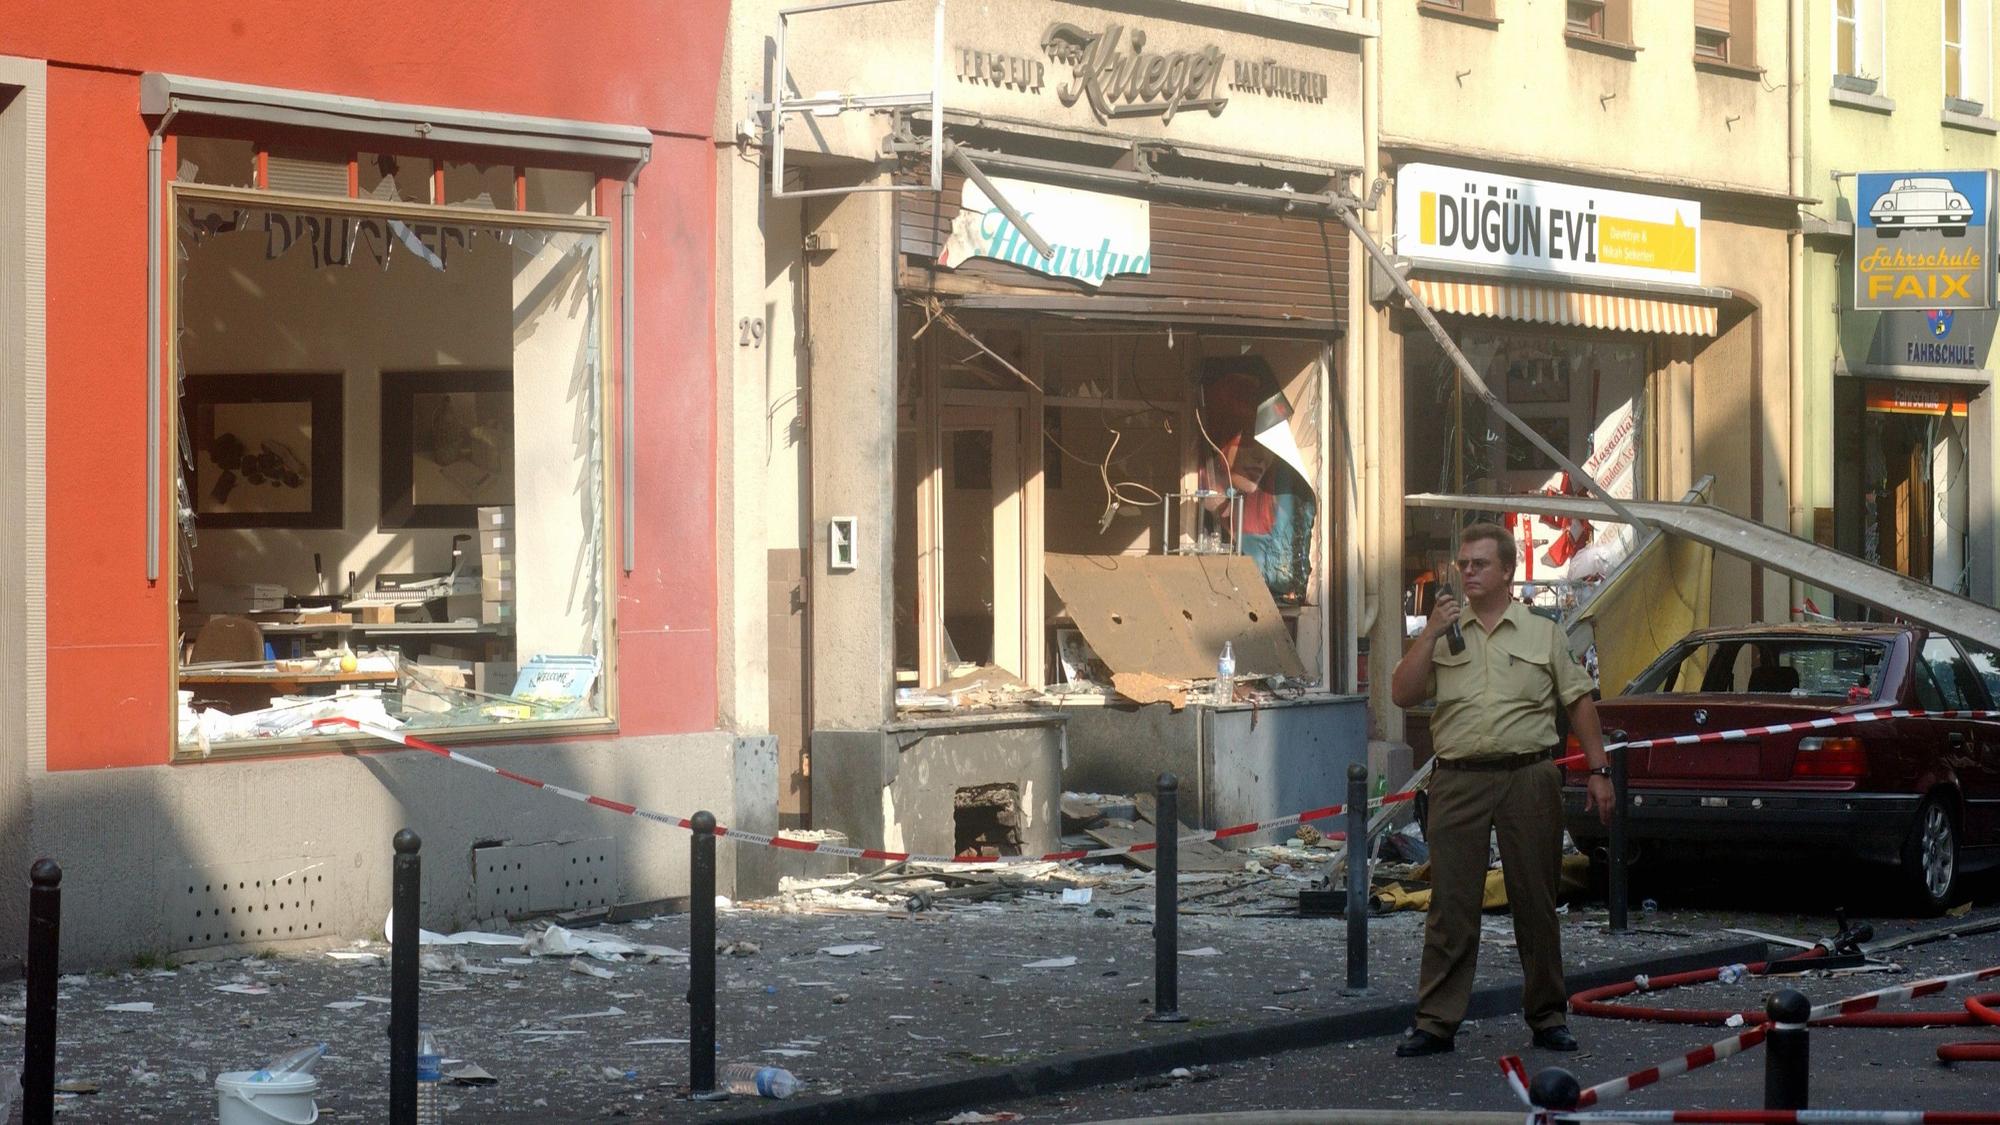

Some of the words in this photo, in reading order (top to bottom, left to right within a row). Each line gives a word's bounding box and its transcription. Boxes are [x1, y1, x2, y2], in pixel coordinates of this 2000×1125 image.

[955, 48, 1045, 88] FRISEUR
[1041, 23, 1228, 117] Krieger
[1549, 200, 1597, 263] EVİ
[1860, 245, 1981, 272] Fahrschule
[1869, 274, 1971, 299] FAIX
[739, 316, 765, 348] 29
[1907, 342, 1975, 365] FAHRSCHULE
[536, 671, 570, 684] WELCOME
